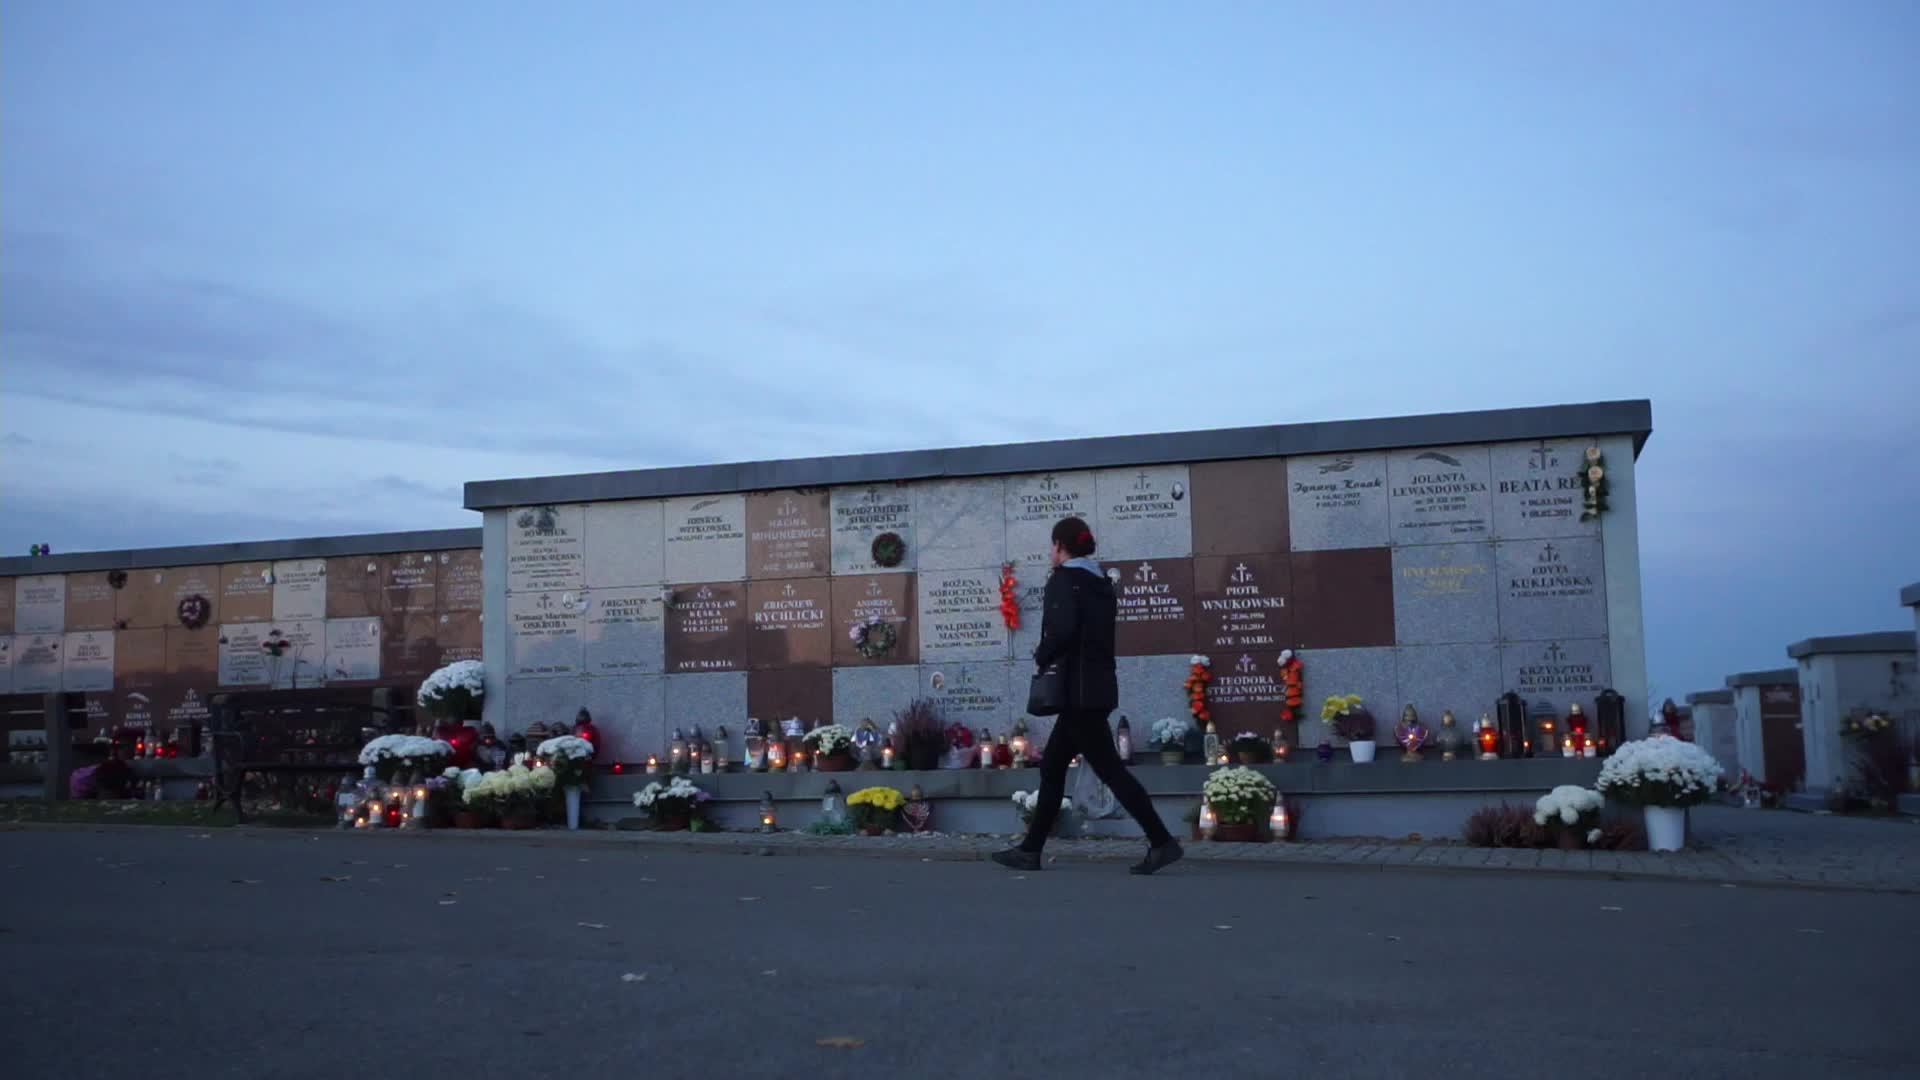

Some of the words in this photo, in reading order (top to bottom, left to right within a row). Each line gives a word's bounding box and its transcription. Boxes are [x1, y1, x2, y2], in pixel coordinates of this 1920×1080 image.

[1411, 472, 1467, 485] JOLANTA
[1391, 482, 1488, 498] LEWANDOWSKA
[1498, 479, 1553, 494] BEATA
[1020, 492, 1080, 504] STANISŁAW
[1531, 564, 1570, 575] EDYTA
[943, 578, 982, 588] BOŻENA
[1123, 584, 1170, 596] KOPACZ
[1226, 585, 1260, 596] PIOTR
[600, 598, 648, 609] ZBIGNIEW
[763, 600, 816, 610] ZBIGNIEW
[1116, 597, 1147, 607] Maria
[1149, 595, 1178, 605] Klara
[1200, 597, 1286, 610] WNUKOWSKI
[754, 608, 825, 623] RYCHLICKI
[934, 621, 992, 632] WALDEMAR
[1216, 636, 1234, 646] AVE
[1240, 635, 1275, 645] MARIA
[679, 661, 698, 669] AVE
[701, 660, 734, 668] MARIA
[1519, 663, 1594, 676] KRZYSZTOF
[1217, 675, 1275, 686] TEODORA
[1206, 683, 1288, 697] STEFANOWICZ
